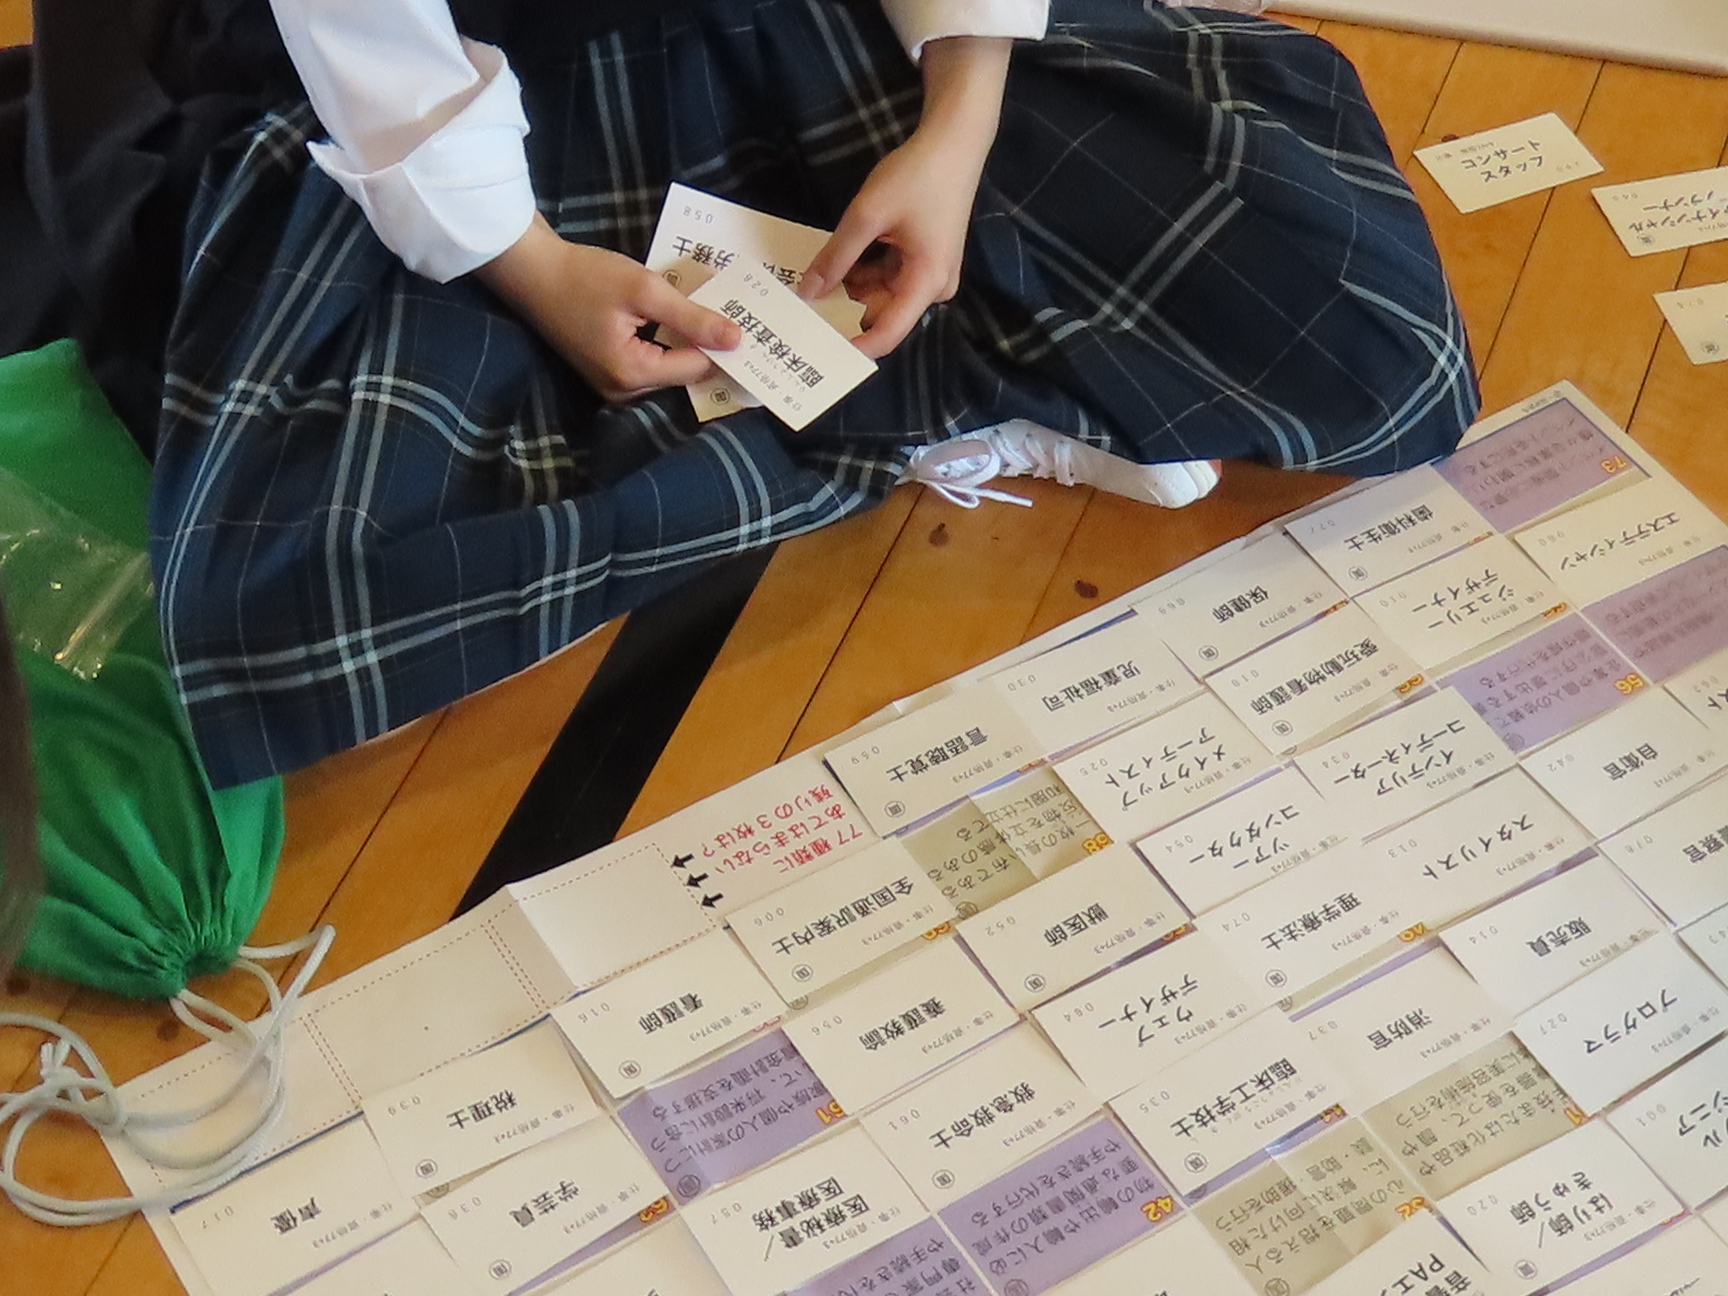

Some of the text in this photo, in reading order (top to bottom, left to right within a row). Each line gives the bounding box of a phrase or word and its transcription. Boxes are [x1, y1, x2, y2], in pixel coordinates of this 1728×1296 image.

[1460, 139, 1542, 170] コンサート
[1480, 155, 1544, 183] スタッフ
[720, 298, 825, 388] 臨床検査技師
[1344, 504, 1432, 550] 歯科衛生士
[1560, 512, 1679, 570] エステティシャン
[1212, 586, 1268, 622] 保健師
[1412, 569, 1497, 611] デザイナー
[1428, 584, 1513, 628] ジュエリー
[1042, 660, 1140, 711] 児童福祉司
[1250, 638, 1377, 714] 愛玩動物看護師
[1609, 670, 1646, 696] 56
[886, 727, 987, 781] 言語聴覚士
[1105, 727, 1214, 787] アーティスト
[1122, 744, 1225, 810] メイクアップ
[1334, 720, 1464, 783] コーディネーター
[1377, 750, 1452, 795] インテリア
[1603, 743, 1657, 780] 自衛官
[714, 805, 846, 875] あてはまらない
[1189, 805, 1299, 862] コンダクター
[1233, 837, 1288, 868] ツアー
[1423, 814, 1533, 878] スタイリスト
[772, 876, 913, 954] 全国通訳案内士
[1044, 903, 1108, 946] 獣医師
[1261, 892, 1360, 949] 理学療法士
[1526, 917, 1590, 956] 販売員
[639, 993, 702, 1033] 看護師
[859, 997, 944, 1049] 養護教諭
[1098, 974, 1197, 1027] デザイナー
[1138, 1006, 1192, 1046] ウェブ
[1584, 989, 1676, 1053] プログラマ
[1367, 1008, 1431, 1050] 消防官
[447, 1090, 516, 1128] 税理士
[929, 1082, 1034, 1147] 救急救命士
[1170, 1058, 1296, 1136] 臨床工学技士
[271, 1197, 320, 1233] 声優
[509, 1181, 578, 1227] 学芸員
[752, 1177, 843, 1230] 医療事務
[1137, 1192, 1179, 1223] 42
[1510, 1171, 1591, 1224] きゅう師
